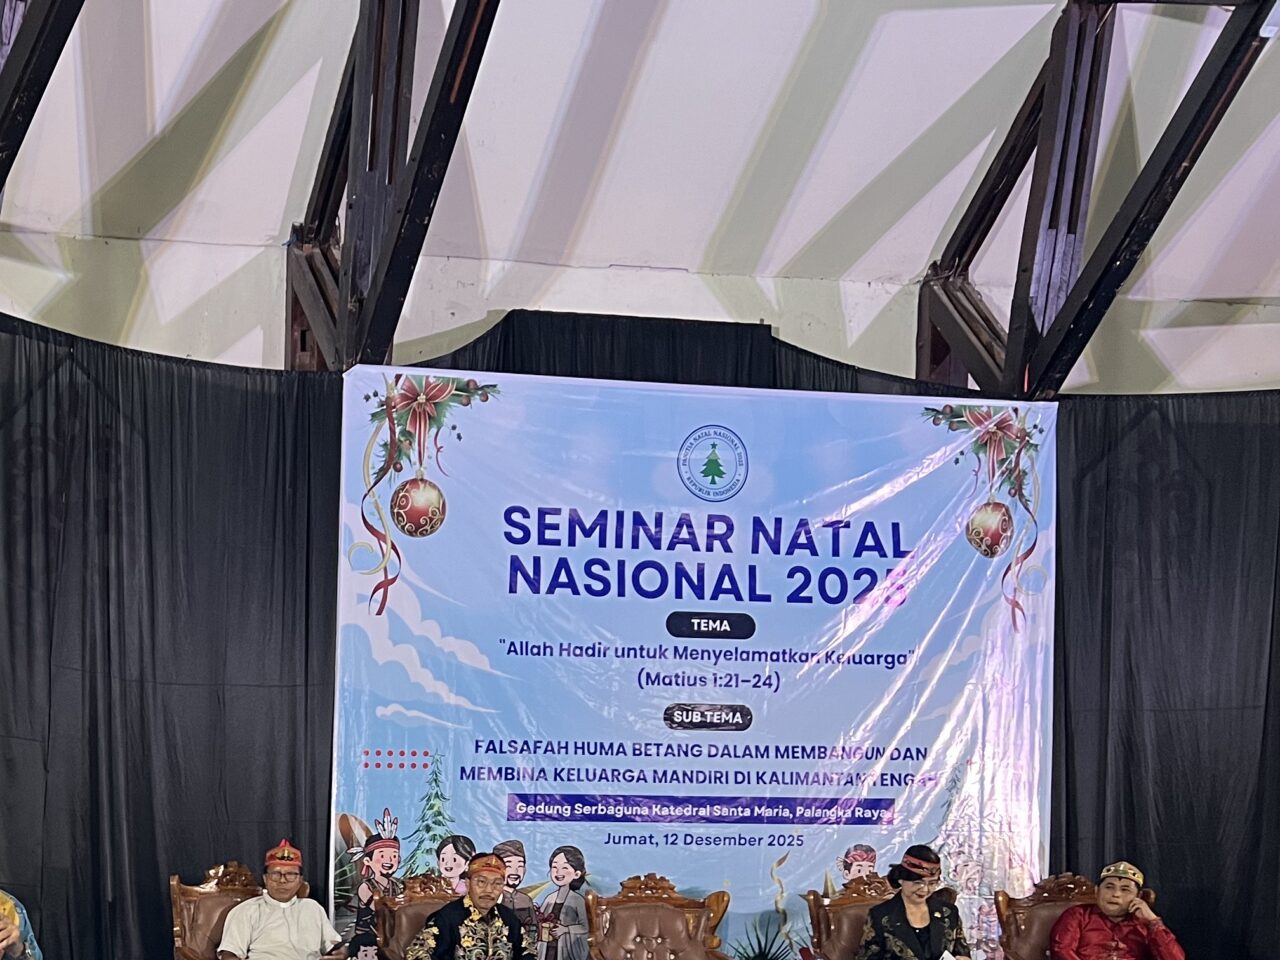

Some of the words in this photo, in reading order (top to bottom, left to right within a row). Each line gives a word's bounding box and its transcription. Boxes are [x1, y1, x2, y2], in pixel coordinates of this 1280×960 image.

[713, 478, 741, 497] INDONESIA
[503, 505, 734, 553] SEMINAR
[751, 515, 915, 559] NATAL
[508, 554, 771, 602] NASIONAL
[691, 618, 731, 632] TEMA
[499, 638, 554, 657] "Allah
[559, 642, 610, 658] Hadir
[614, 644, 669, 660] untuk
[673, 645, 820, 666] Menyelamatkan
[637, 667, 707, 690] (Matius
[673, 711, 701, 723] SUB
[704, 711, 743, 724] TEMA
[474, 739, 569, 755] FALSAFAH
[574, 741, 627, 757] HUMA
[632, 743, 703, 758] BETANG
[707, 744, 770, 760] DALAM
[775, 745, 886, 761] MEMBANGUN
[889, 747, 928, 761] DAN
[459, 766, 548, 782] MEMBINA
[553, 767, 648, 784] KELUARGA
[652, 769, 729, 785] MANDIRI
[734, 770, 751, 785] DI
[516, 802, 571, 817] Gedung
[574, 803, 649, 818] Serbaguna
[652, 804, 710, 817] Katedral
[713, 805, 751, 817] Santa
[753, 806, 794, 819] Maria,
[796, 807, 853, 820] Palangka
[604, 832, 659, 847] Jumat,
[663, 833, 678, 845] 12
[683, 834, 763, 847] Desember
[768, 834, 804, 847] 2025
